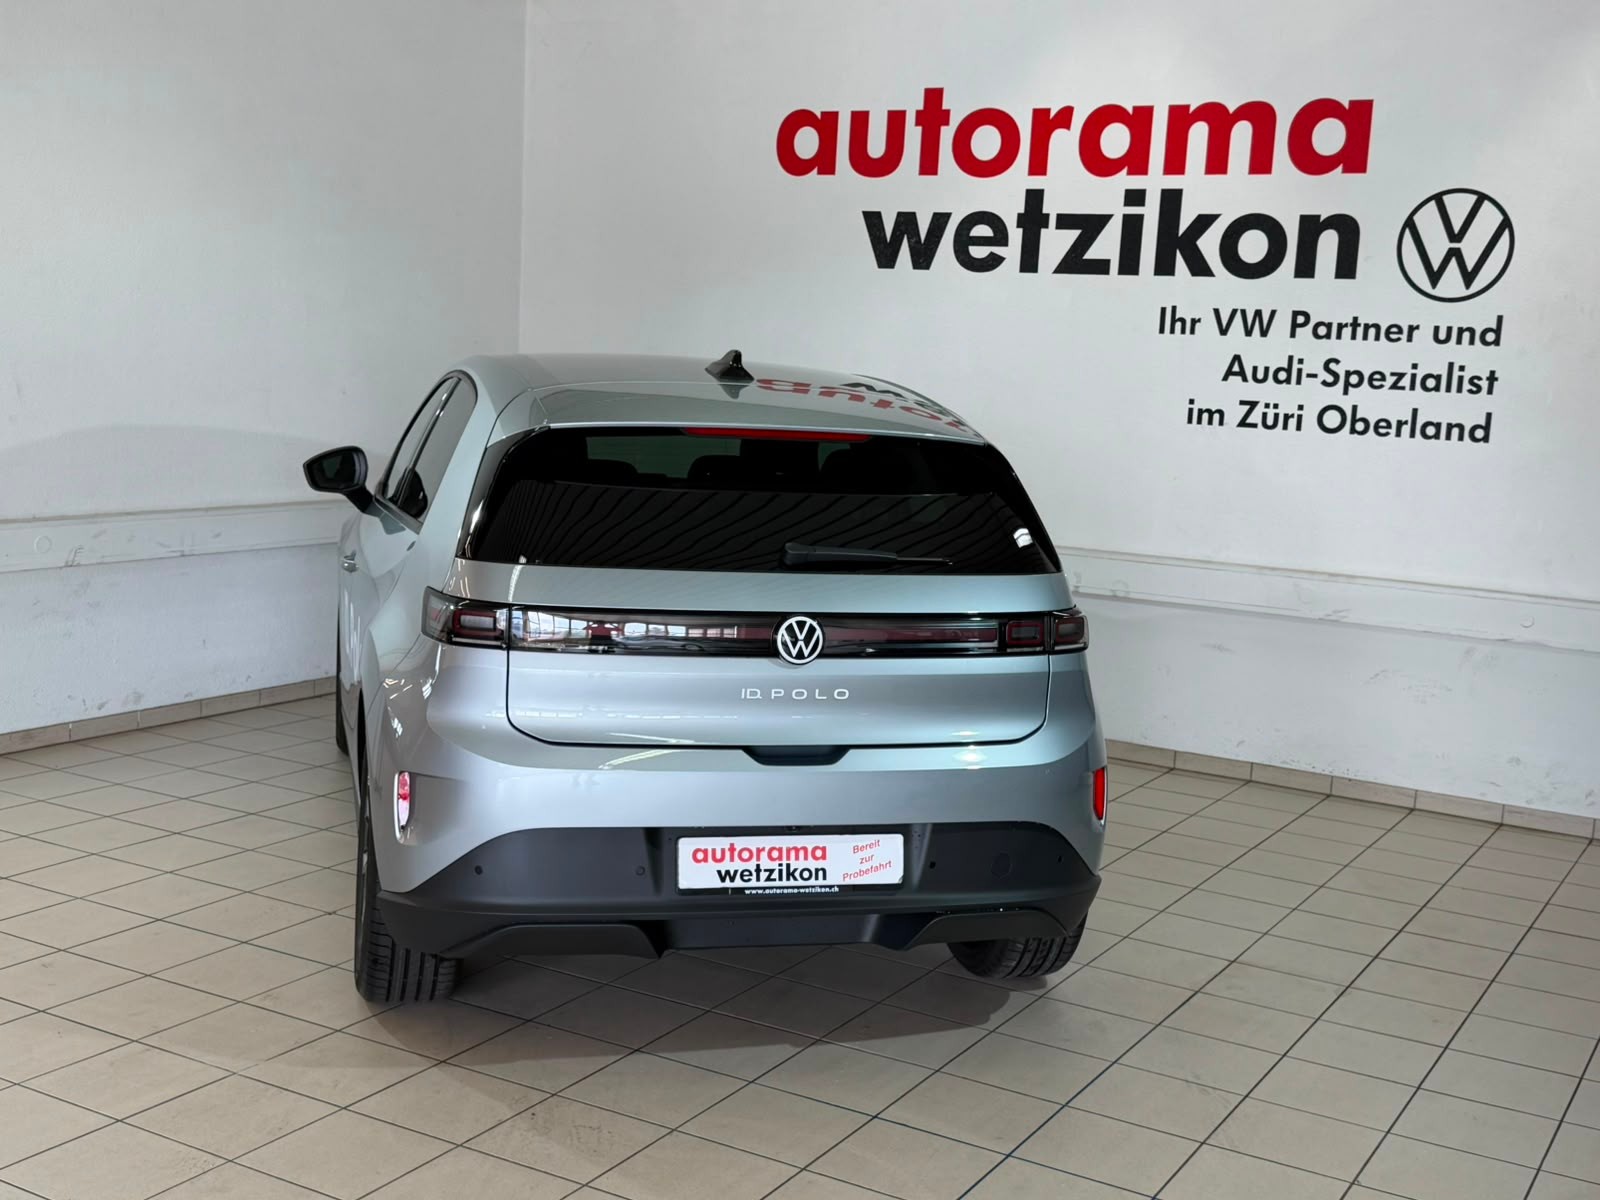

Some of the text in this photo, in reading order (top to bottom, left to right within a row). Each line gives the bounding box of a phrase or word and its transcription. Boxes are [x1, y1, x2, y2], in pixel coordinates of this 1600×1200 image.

[776, 87, 1375, 179] autorama
[862, 188, 1361, 280] wetzikon
[1396, 187, 1516, 303] VW
[1158, 306, 1504, 347] Ihr VW Partner und
[1221, 353, 1499, 396] Audi-Spezialist
[1187, 399, 1493, 444] im Züri Oberland
[777, 615, 824, 664] VW
[771, 688, 850, 700] POLO
[691, 842, 828, 865] autorama
[852, 839, 881, 854] Bereit
[859, 854, 874, 865] zur
[716, 863, 828, 883] wetzikon
[842, 860, 892, 882] Probefahrt
[744, 885, 840, 895] www.autorama-wetzikon.ch
